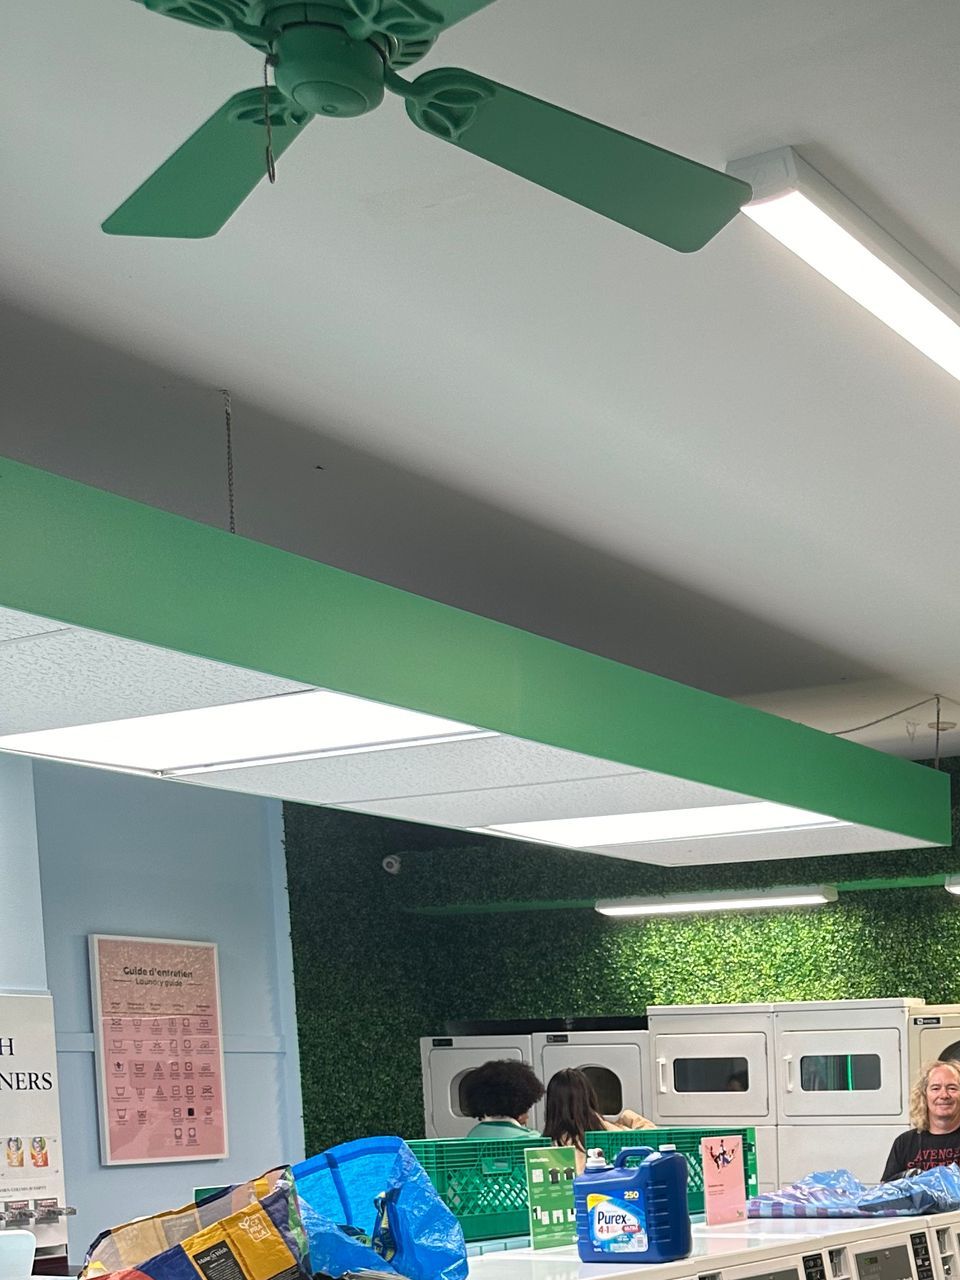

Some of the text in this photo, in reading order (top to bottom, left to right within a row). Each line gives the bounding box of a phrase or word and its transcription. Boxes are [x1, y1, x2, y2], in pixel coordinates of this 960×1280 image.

[123, 967, 193, 978] Guide d'entretien
[135, 978, 183, 988] Laundry guide
[0, 1072, 52, 1091] NERS
[624, 1191, 639, 1199] 250
[598, 1211, 627, 1224] Purex
